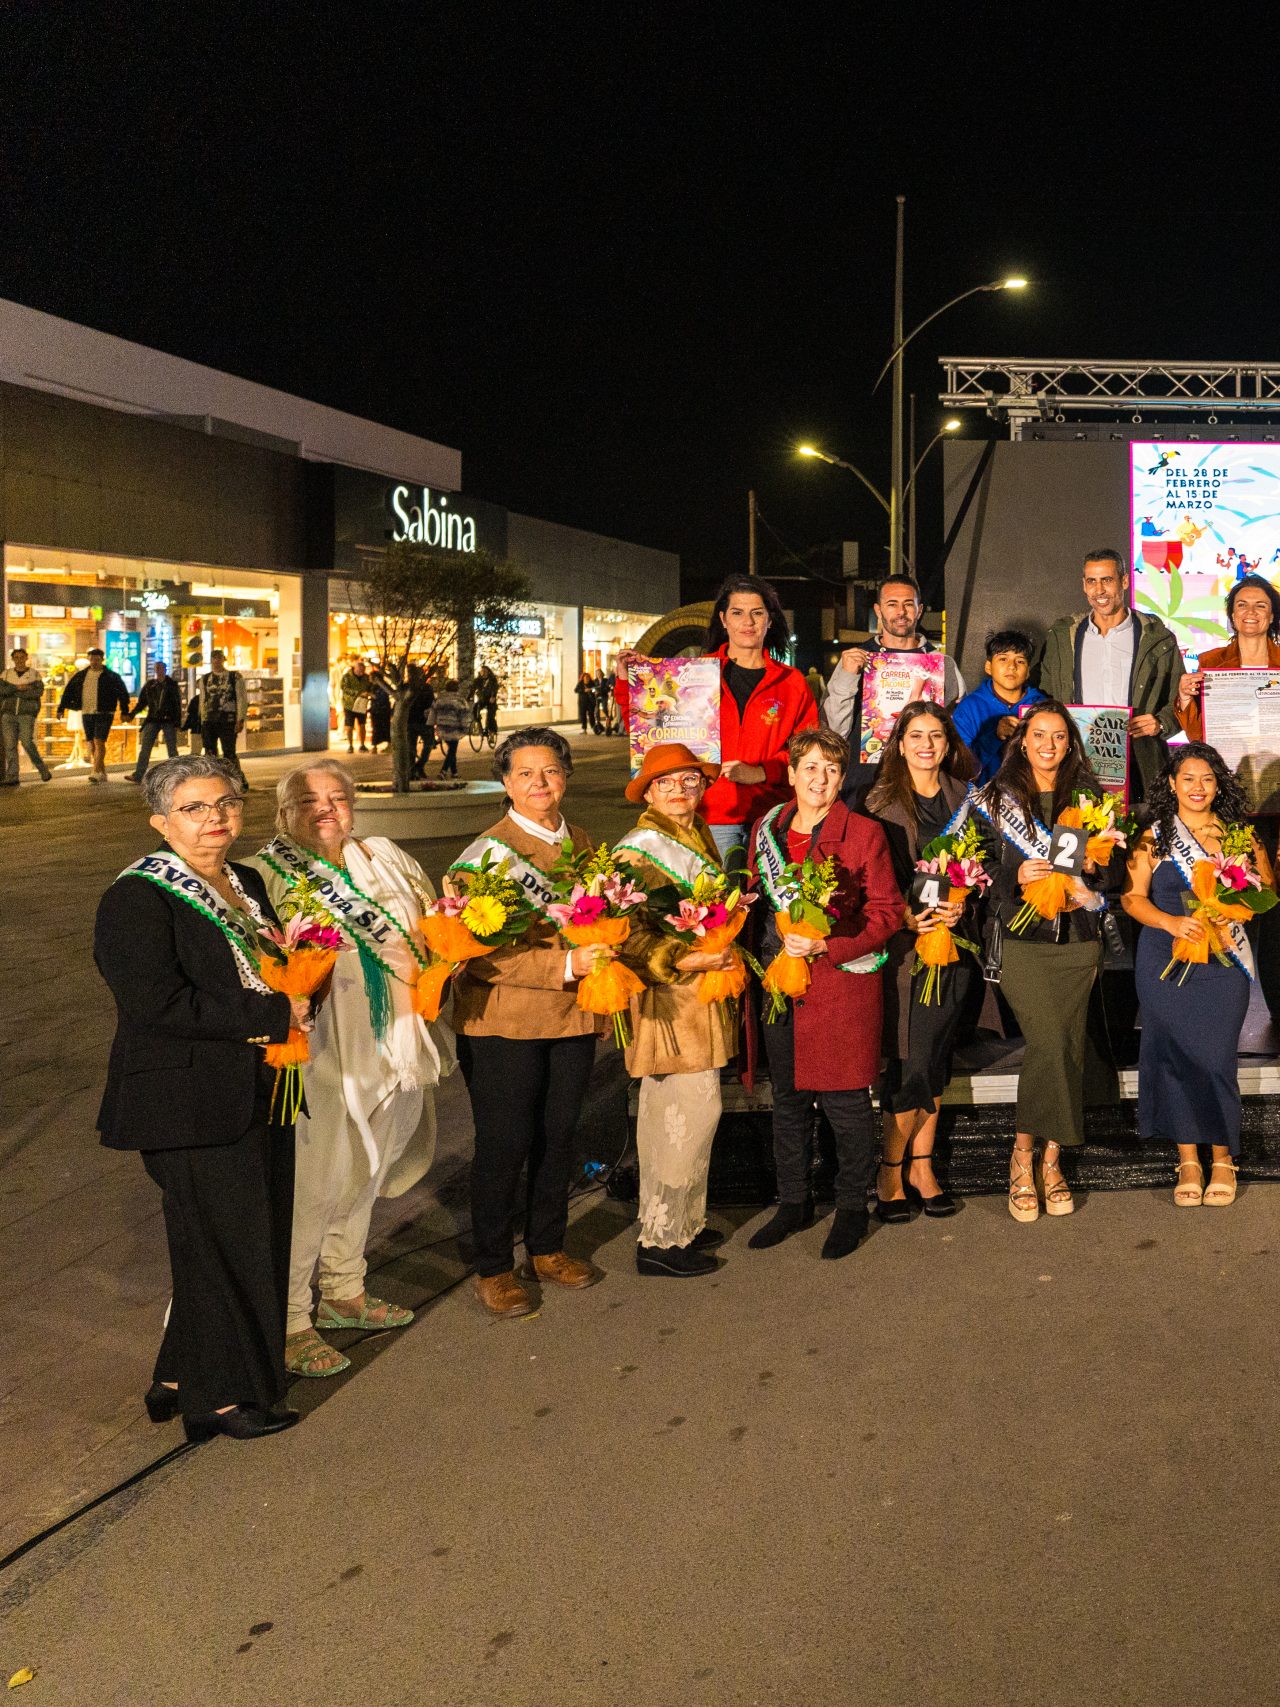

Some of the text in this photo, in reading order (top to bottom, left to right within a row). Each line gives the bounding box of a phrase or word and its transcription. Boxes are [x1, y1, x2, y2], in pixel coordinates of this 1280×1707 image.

[1166, 468, 1228, 477] DEL 28 DE
[1166, 479, 1221, 488] FEBRERO
[1166, 490, 1218, 499] AL 15 DE
[1166, 501, 1213, 509] MARZO
[393, 486, 476, 553] Sabina
[881, 671, 911, 680] CARRERA
[880, 679, 911, 688] TACONES
[1094, 716, 1126, 730] CAR
[647, 727, 708, 743] CORRALEJO
[1089, 728, 1122, 745] 20 NA
[1090, 736, 1101, 745] 26
[1093, 745, 1122, 758] VAL
[1054, 832, 1079, 868] 2
[919, 879, 940, 908] 4
